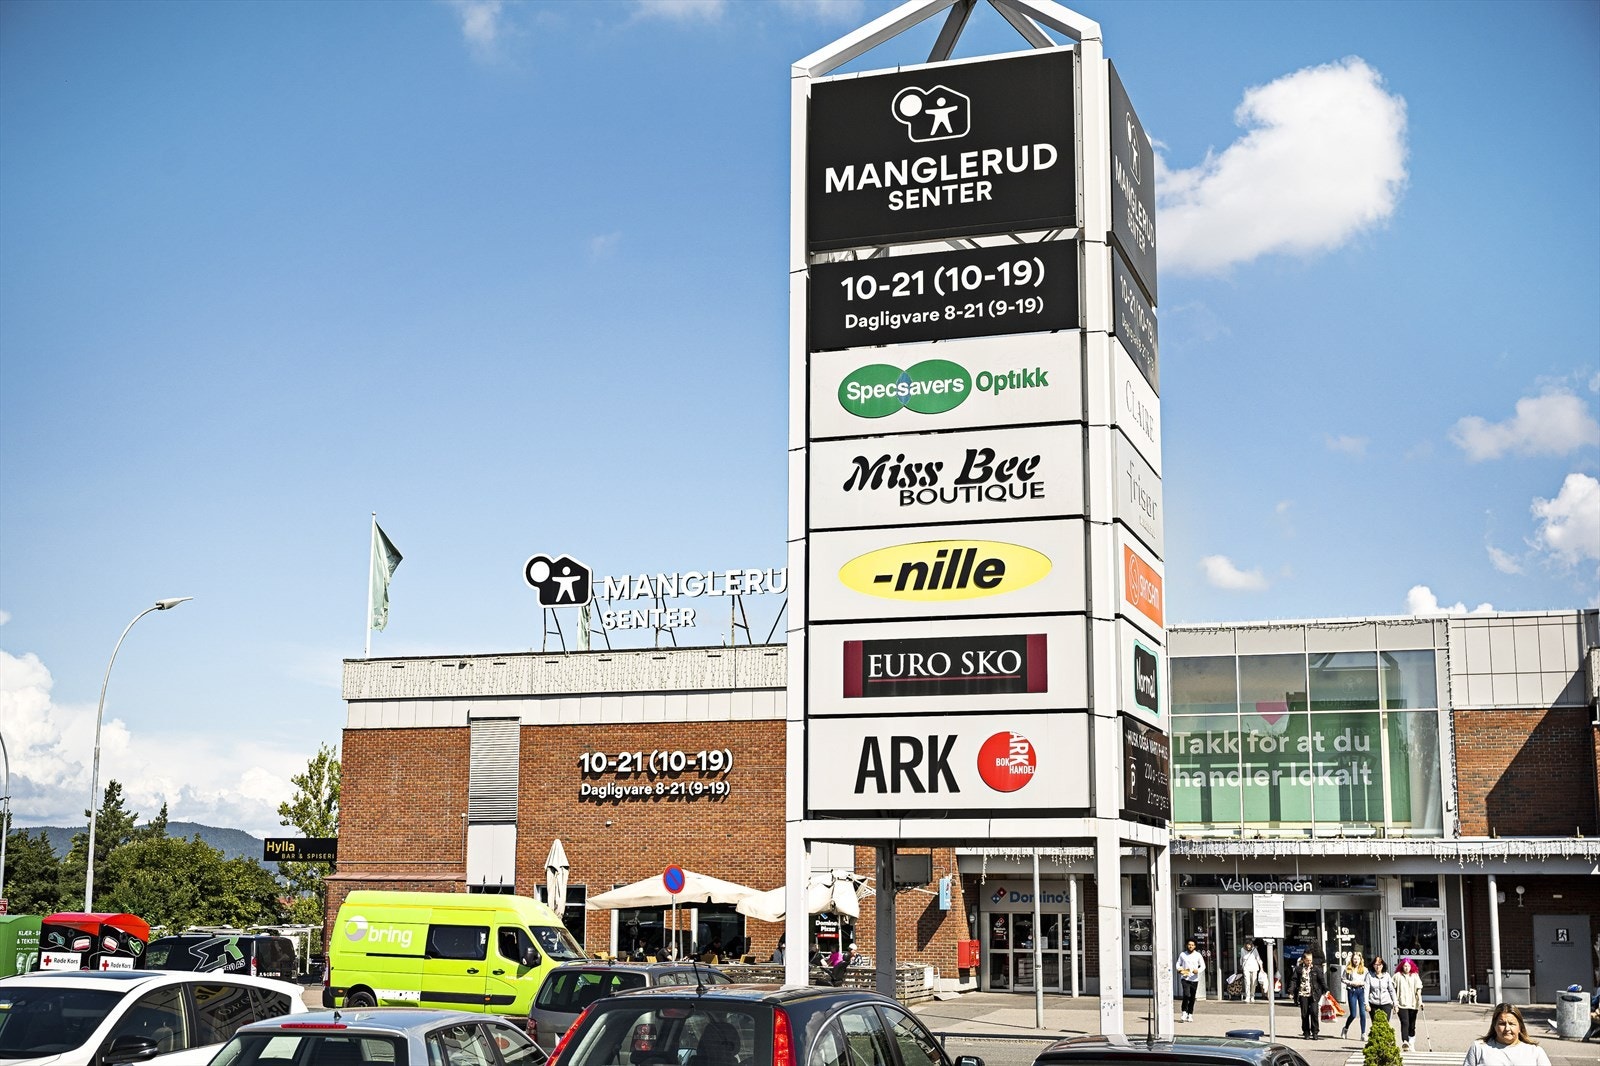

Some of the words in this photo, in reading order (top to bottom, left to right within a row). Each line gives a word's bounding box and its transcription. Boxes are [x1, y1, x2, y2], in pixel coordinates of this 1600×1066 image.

[825, 143, 1058, 193] MANGLERUD
[888, 180, 993, 211] SENTER
[1115, 155, 1155, 248] MANGLERUD
[1127, 207, 1146, 255] SENTER
[841, 270, 925, 301] 10-21
[934, 256, 1046, 297] (10-19)
[845, 308, 940, 330] Dagligvare
[944, 304, 984, 321] 8-21
[988, 296, 1044, 318] (9-19)
[846, 377, 965, 404] Specsavers
[975, 367, 1049, 396] Optikk
[843, 453, 944, 492] Miss
[954, 447, 1041, 486] Bee
[900, 481, 1046, 507] BOUTIQUE
[603, 567, 788, 601] MANGLERU
[873, 547, 1006, 592] -nille
[602, 607, 696, 630] SENTER
[868, 652, 951, 679] EURO
[961, 649, 1023, 676] SKO
[1010, 731, 1029, 766] ARK
[1174, 730, 1239, 755] Takk
[1247, 729, 1290, 754] for
[1297, 731, 1325, 752] at
[1333, 728, 1370, 753] du
[579, 751, 644, 774] 10-21
[649, 748, 733, 775] (10-19)
[854, 734, 961, 794] ARK
[996, 758, 1010, 767] BOK
[1010, 765, 1035, 775] HANDEL
[1175, 762, 1283, 789] handler
[1290, 761, 1373, 787] lokalt
[581, 782, 652, 799] Dagligvare
[655, 782, 686, 796] 8-21
[688, 780, 731, 797] (9-19)
[266, 841, 296, 854] Hylla
[1220, 877, 1313, 892] Velkommen
[367, 924, 413, 949] bring
